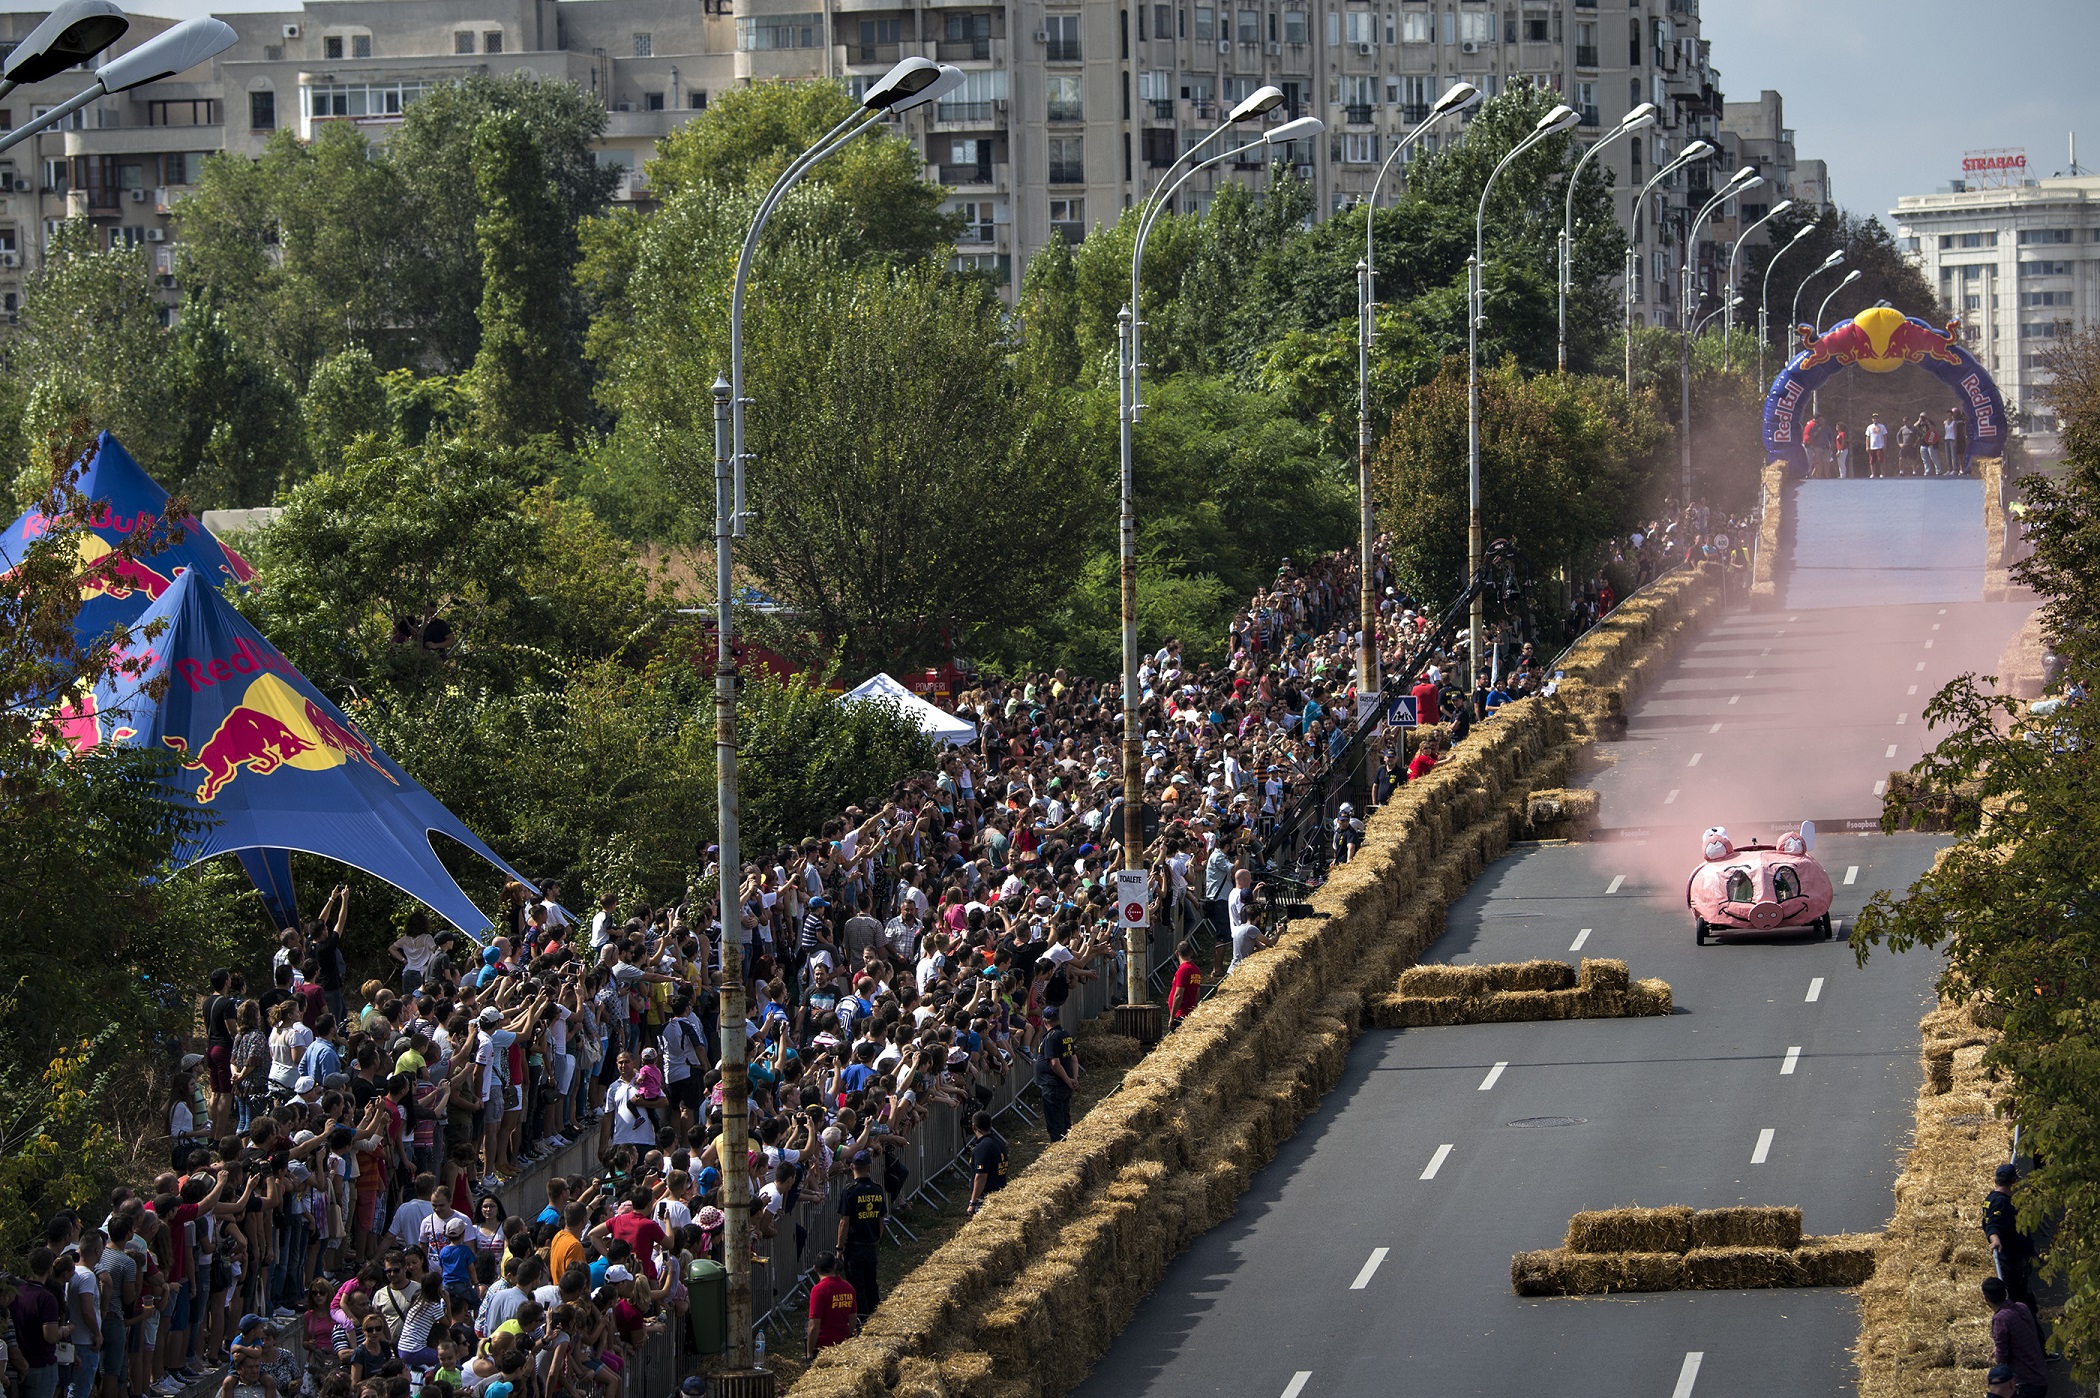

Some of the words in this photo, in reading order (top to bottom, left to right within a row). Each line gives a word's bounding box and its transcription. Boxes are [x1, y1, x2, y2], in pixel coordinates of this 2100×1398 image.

[1962, 155, 2026, 171] STRABAG
[1777, 379, 1804, 411] Bull
[1961, 373, 1991, 407] Red
[1774, 409, 1792, 442] Red
[1975, 405, 1997, 437] Bull
[174, 636, 261, 693] Red
[915, 682, 946, 691] POMPIERI
[1846, 819, 1878, 830] #soapbox
[1119, 875, 1142, 884] TOALETE
[831, 1301, 852, 1309] FIRE
